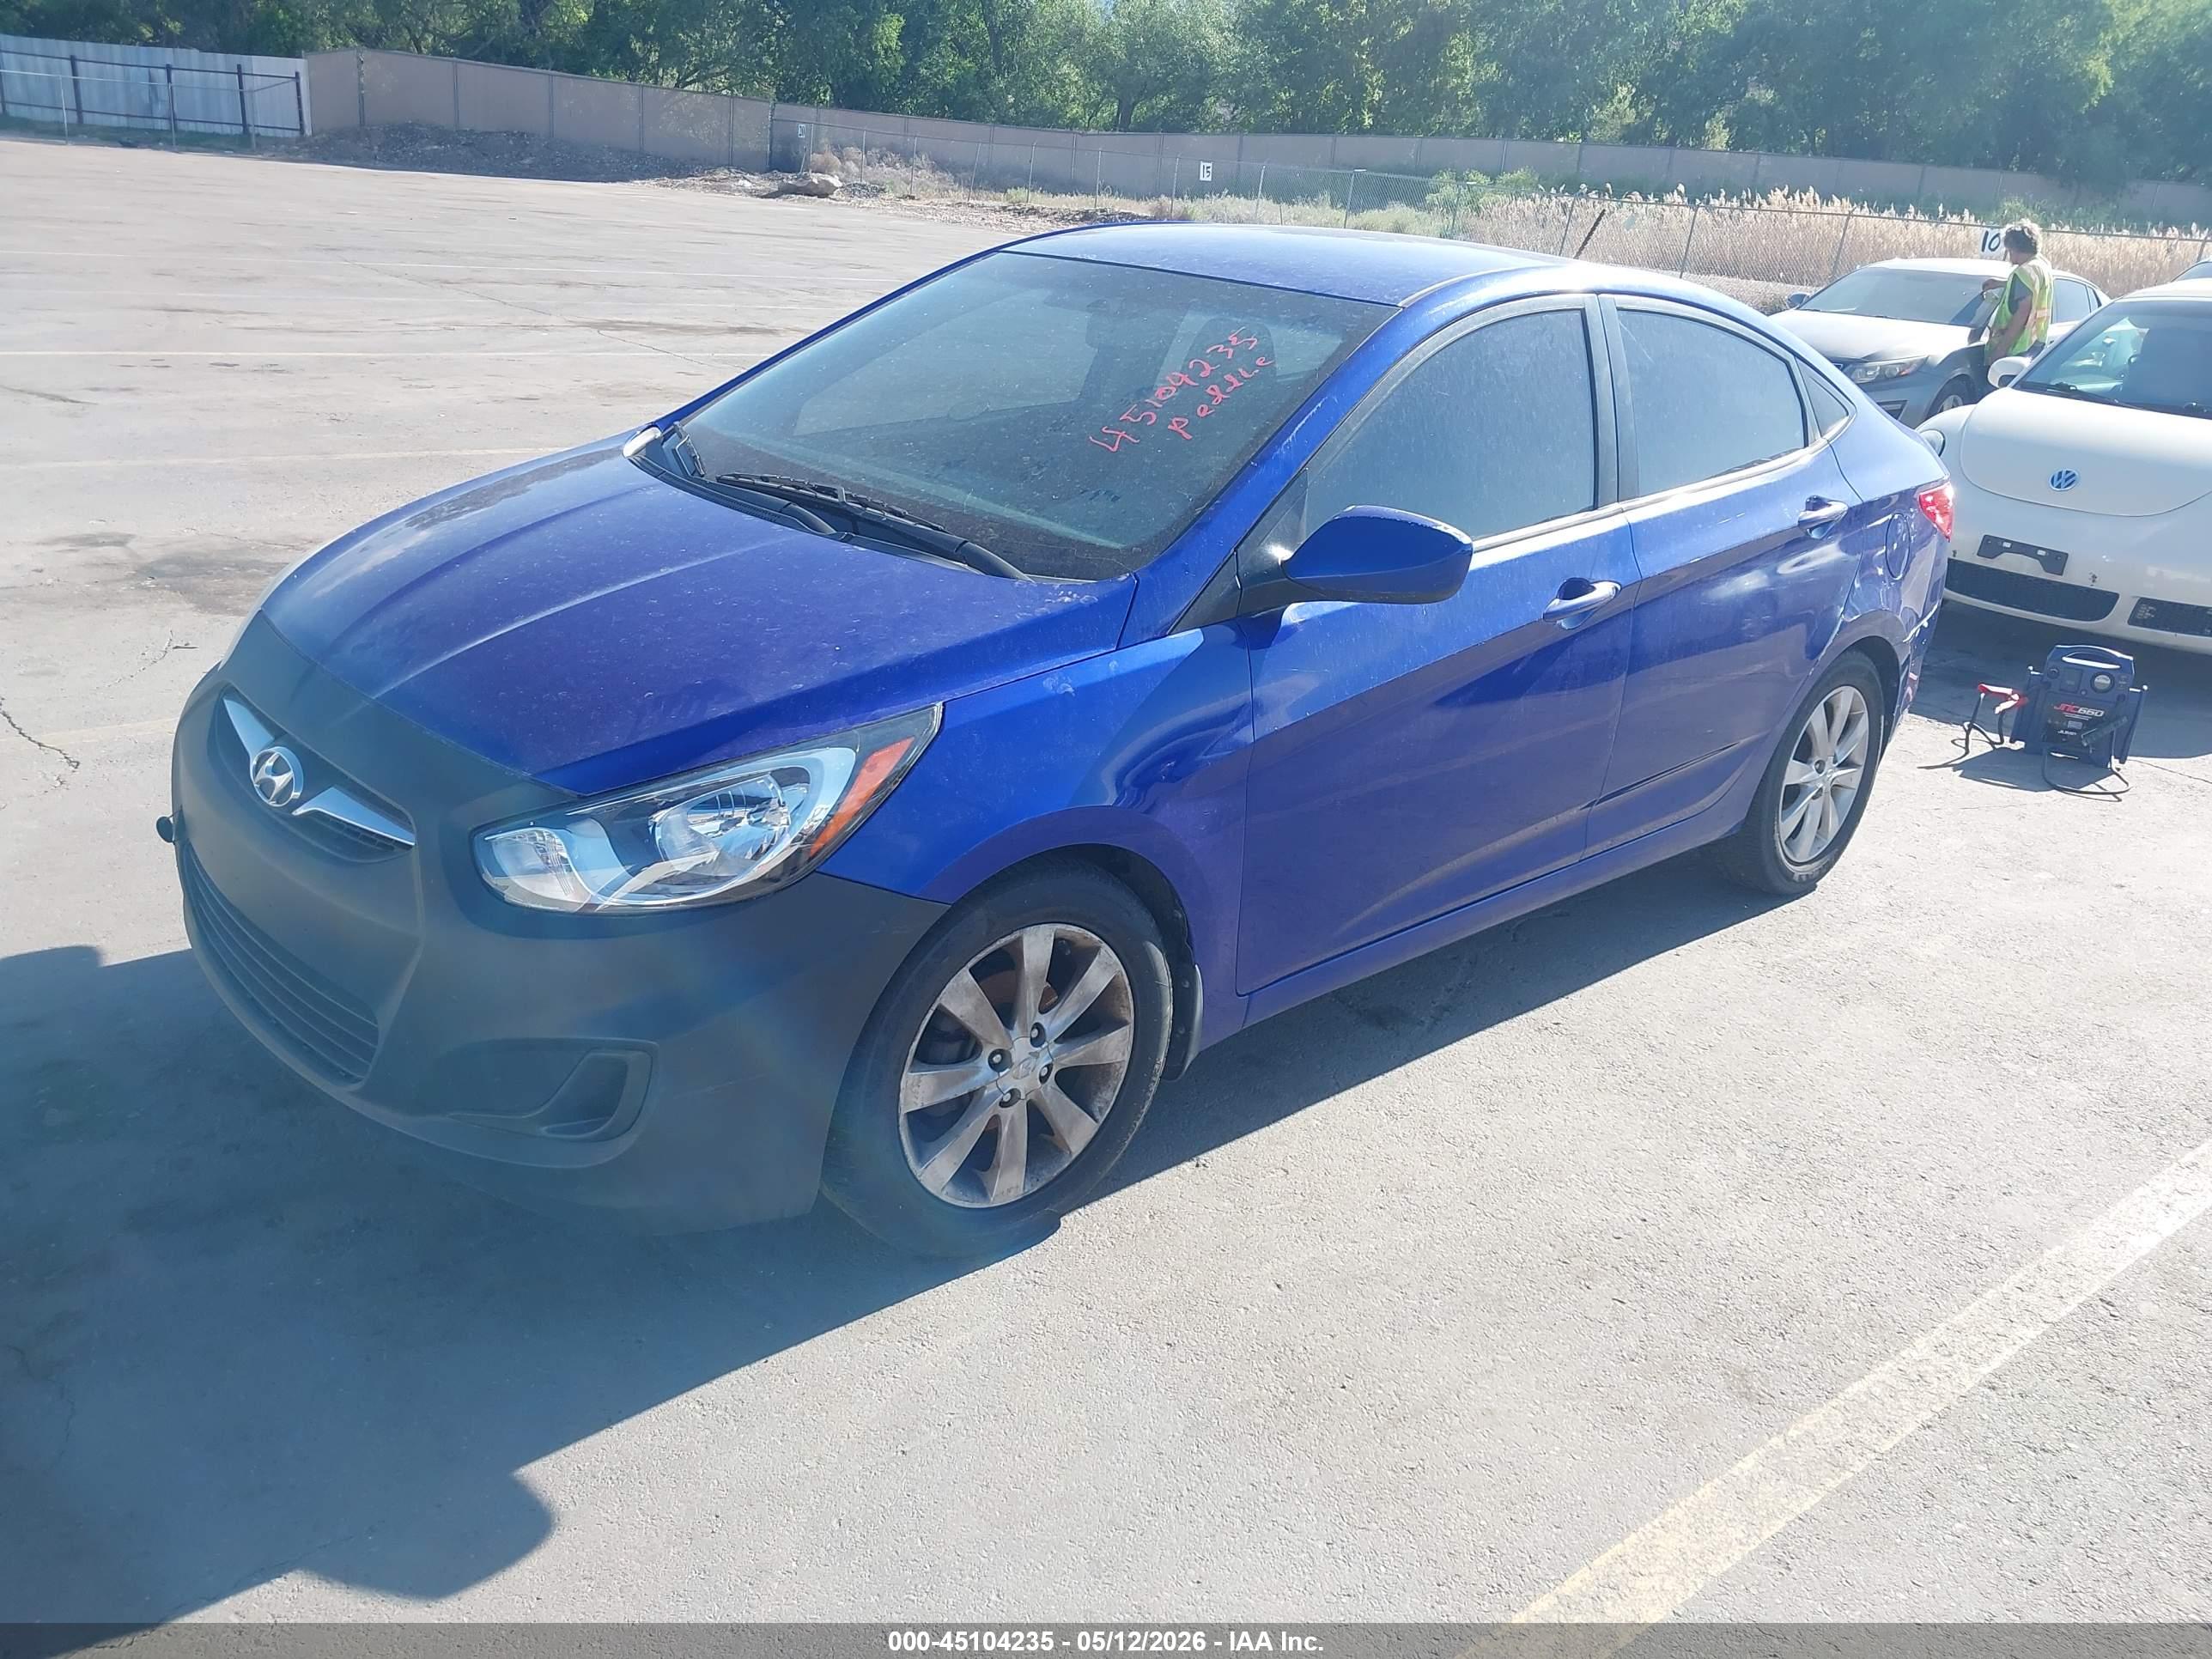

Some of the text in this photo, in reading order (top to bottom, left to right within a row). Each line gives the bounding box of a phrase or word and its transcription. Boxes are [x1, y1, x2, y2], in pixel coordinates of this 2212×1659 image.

[1202, 164, 1211, 179] 15
[1981, 230, 2001, 252] 10
[1089, 326, 1258, 452] 45104235
[2054, 703, 2105, 717] JNC660
